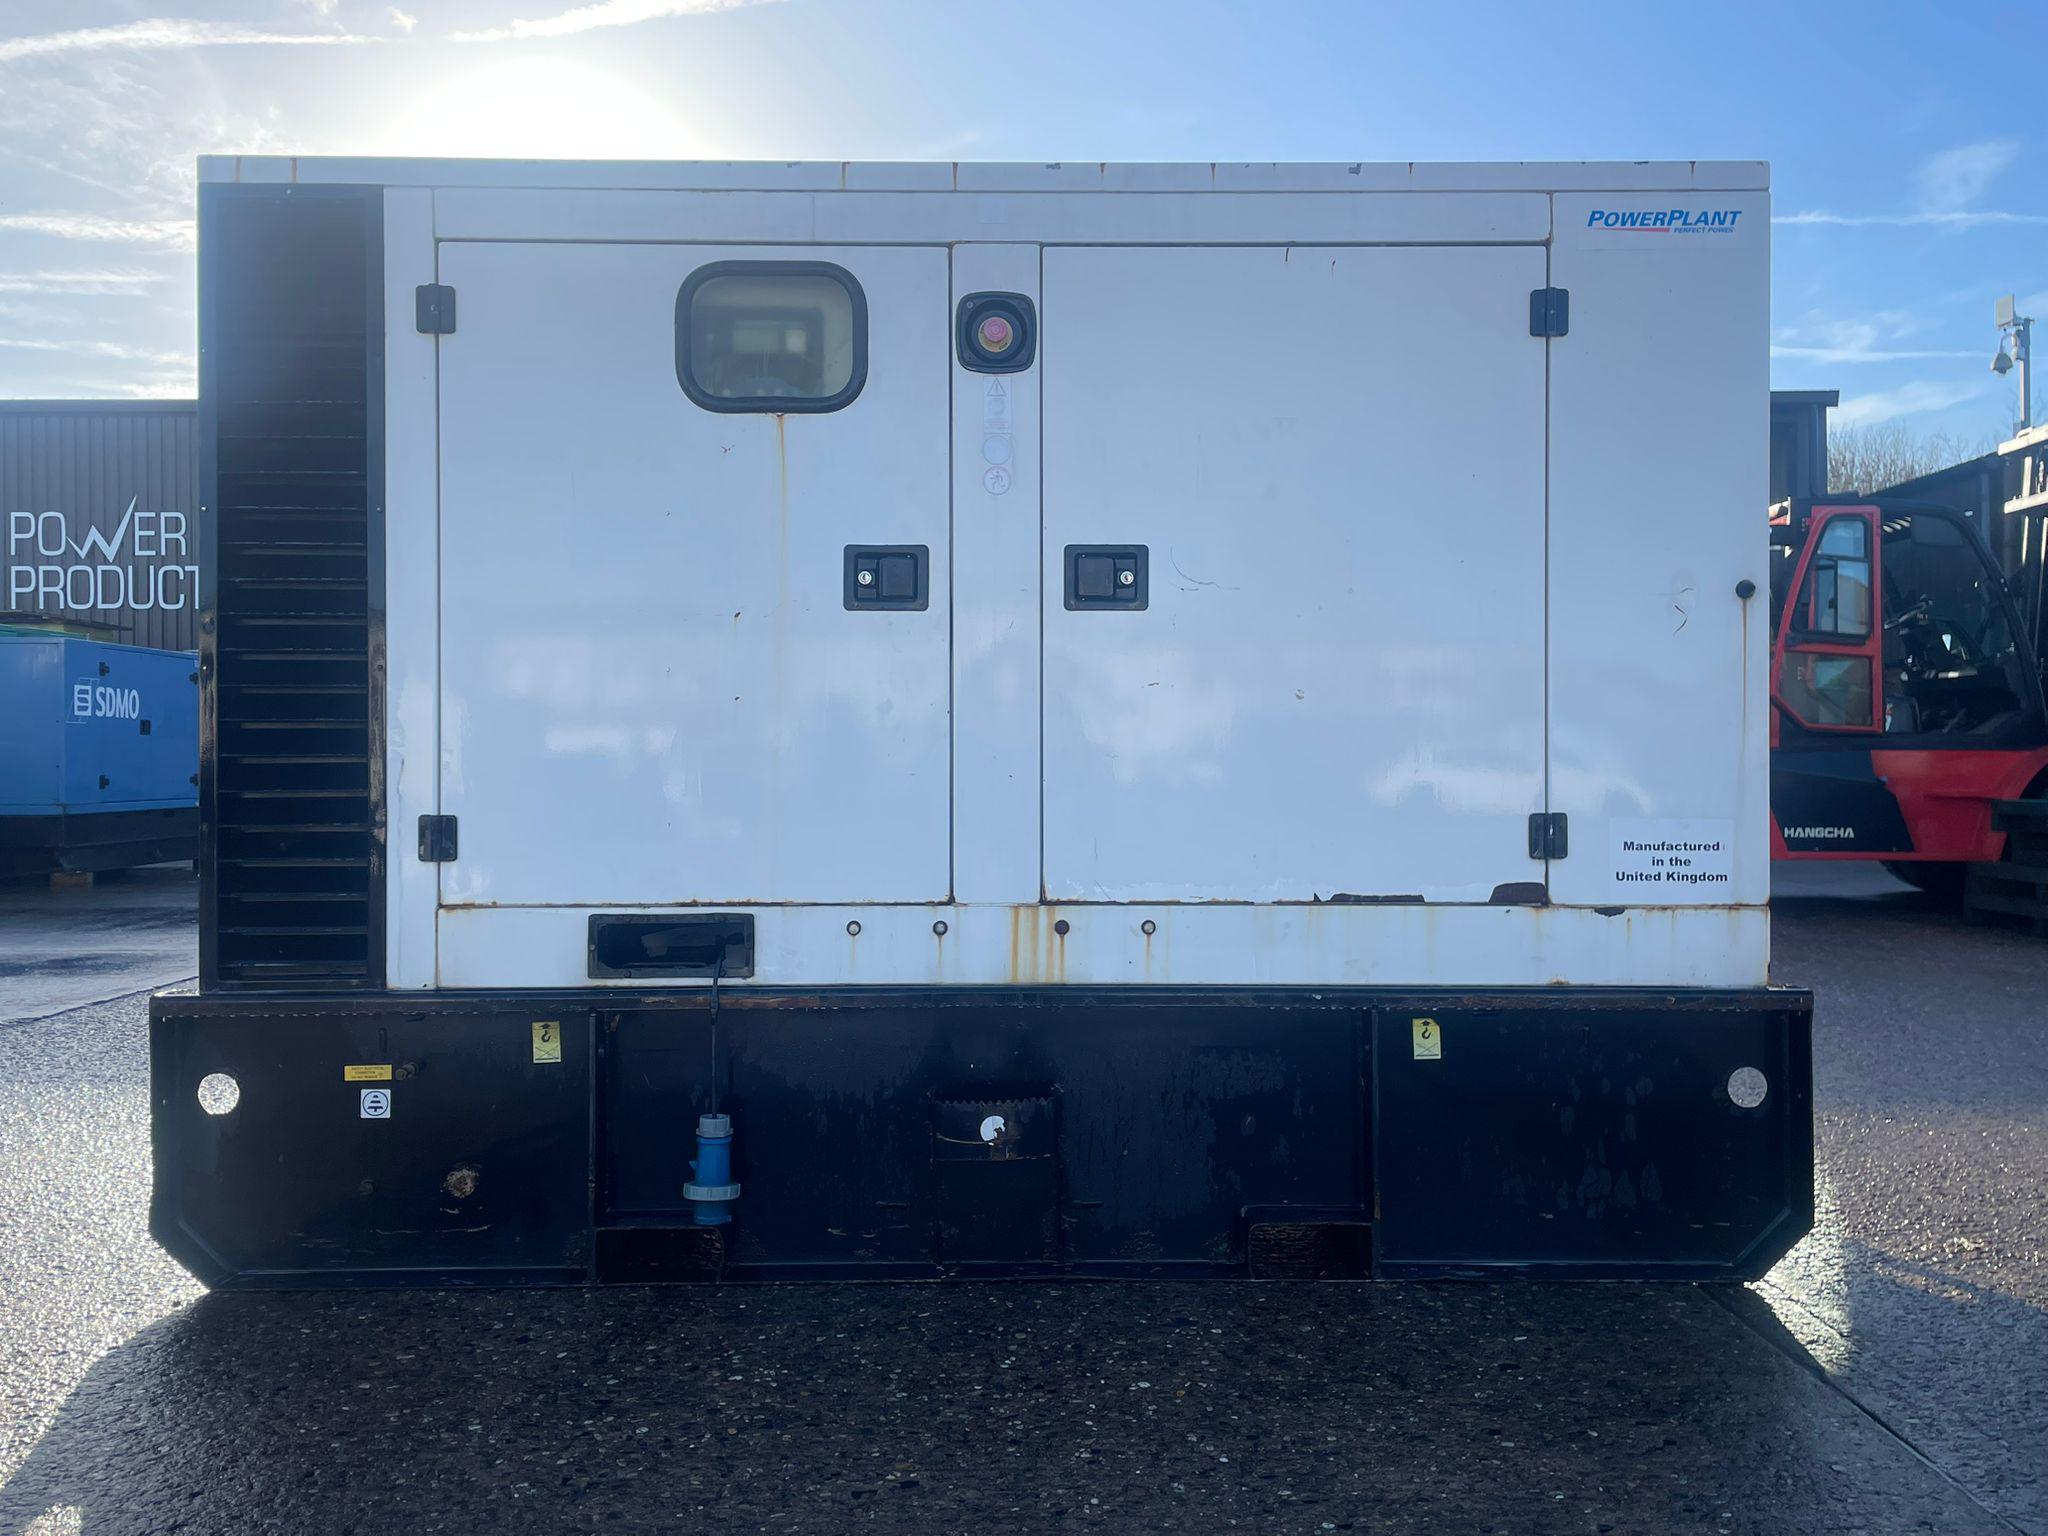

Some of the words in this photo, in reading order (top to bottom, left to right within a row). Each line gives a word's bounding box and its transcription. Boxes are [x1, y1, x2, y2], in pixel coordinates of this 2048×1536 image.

[10, 495, 187, 563] POWER
[95, 686, 140, 720] SDMO
[1784, 827, 1855, 838] HANGCHA
[1623, 841, 1720, 851] Manufactured
[1652, 856, 1664, 866] in
[1669, 856, 1691, 866] the
[1615, 871, 1661, 881] United
[1666, 871, 1728, 884] Kingdom
